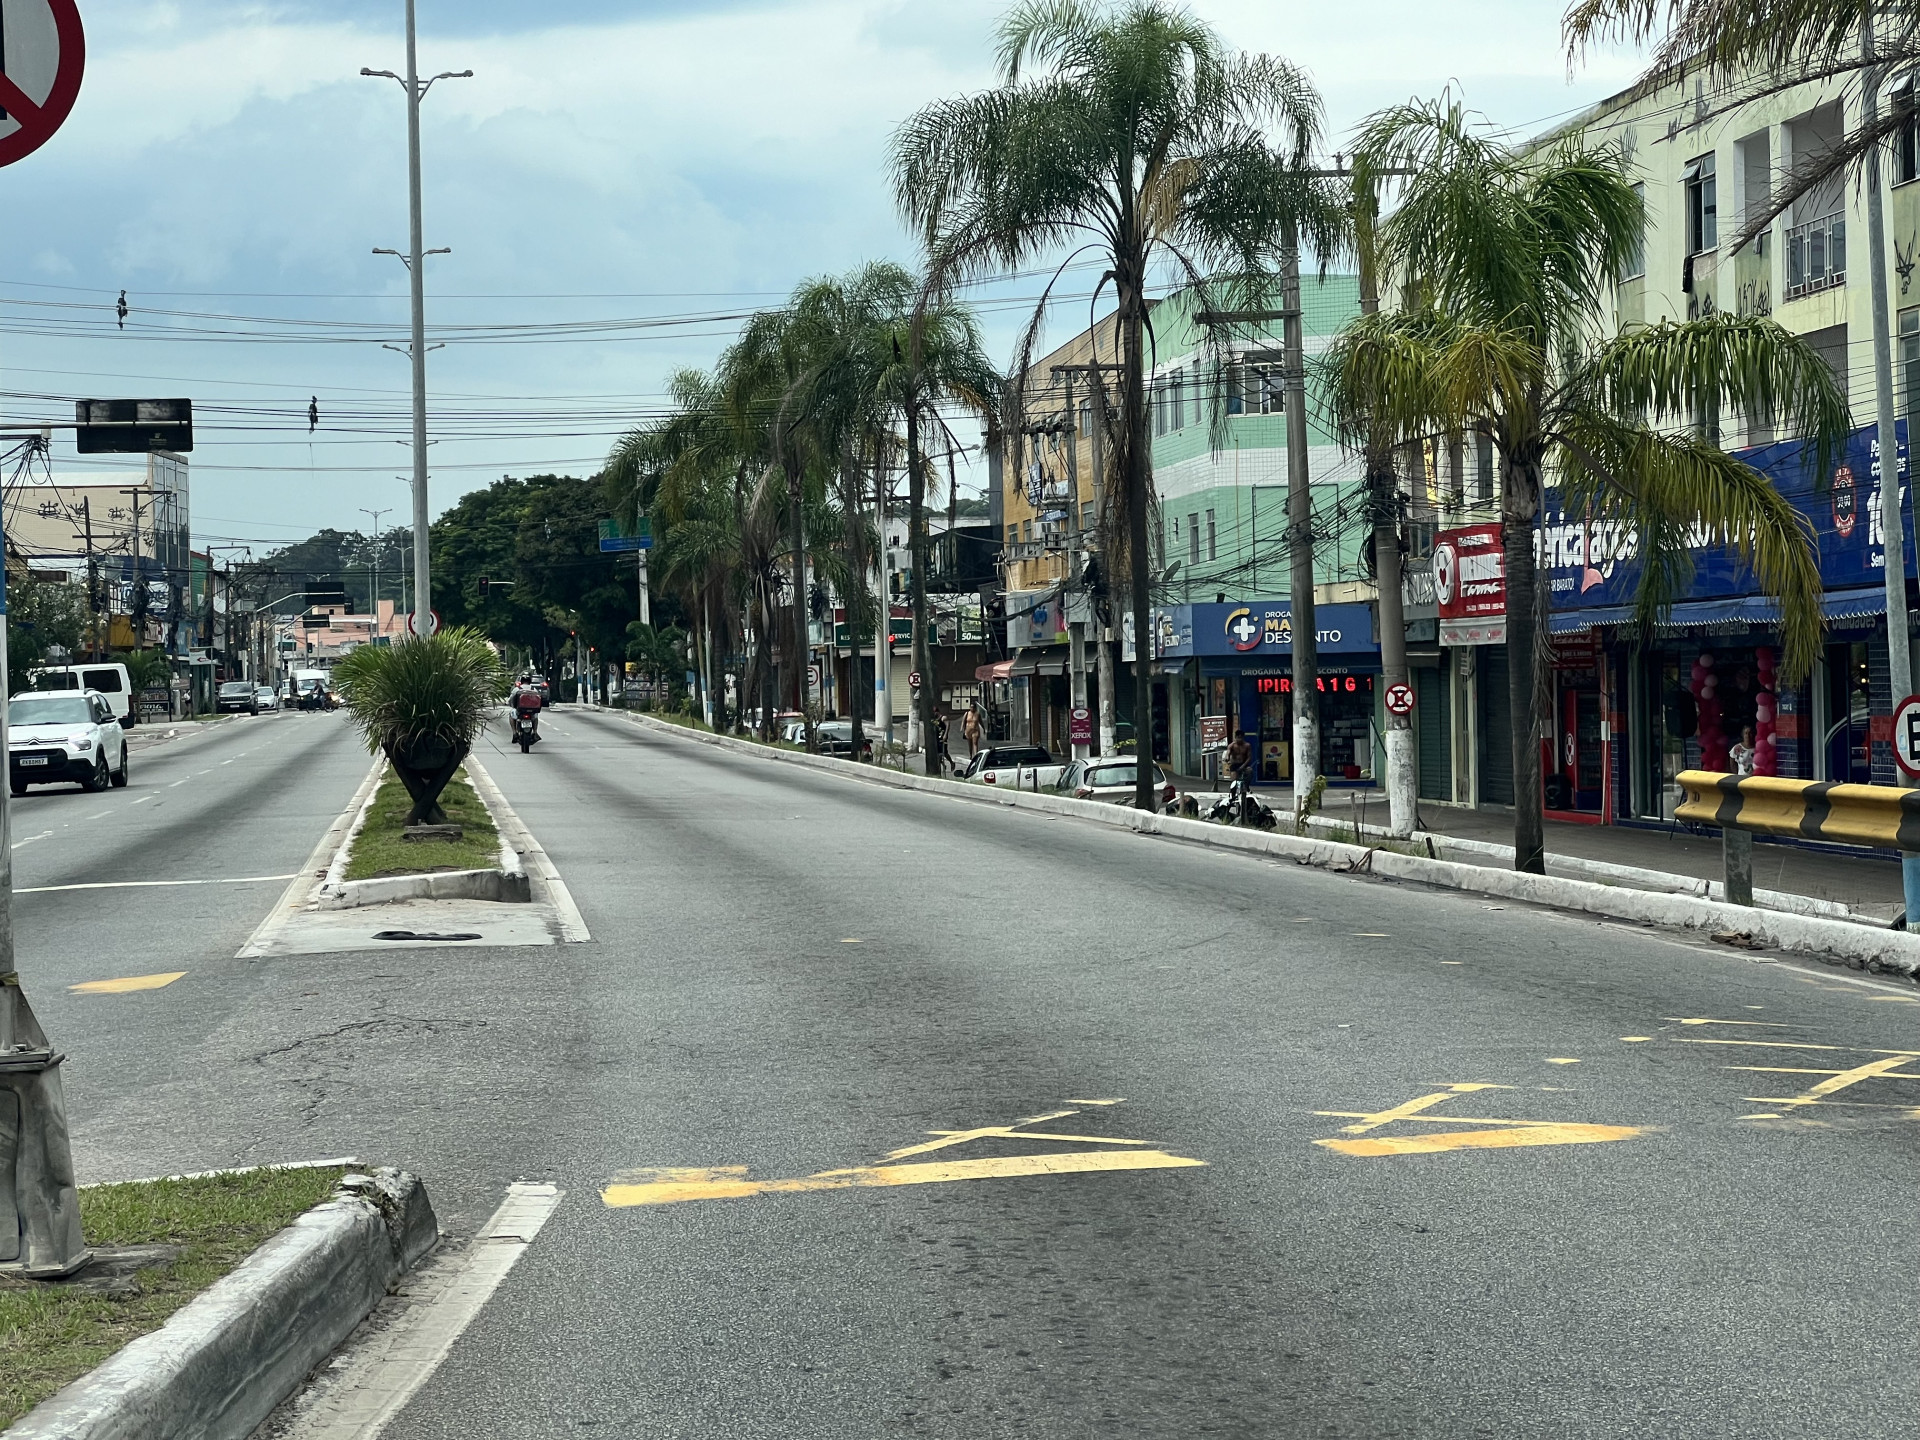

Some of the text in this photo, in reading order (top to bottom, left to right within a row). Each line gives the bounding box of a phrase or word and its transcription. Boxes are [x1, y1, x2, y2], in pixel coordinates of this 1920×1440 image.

[1532, 507, 1584, 569] mérica
[1265, 619, 1292, 631] MA
[1265, 630, 1342, 643] DESNTO
[1316, 667, 1348, 675] SCONTO
[1259, 678, 1325, 693] IPIRA
